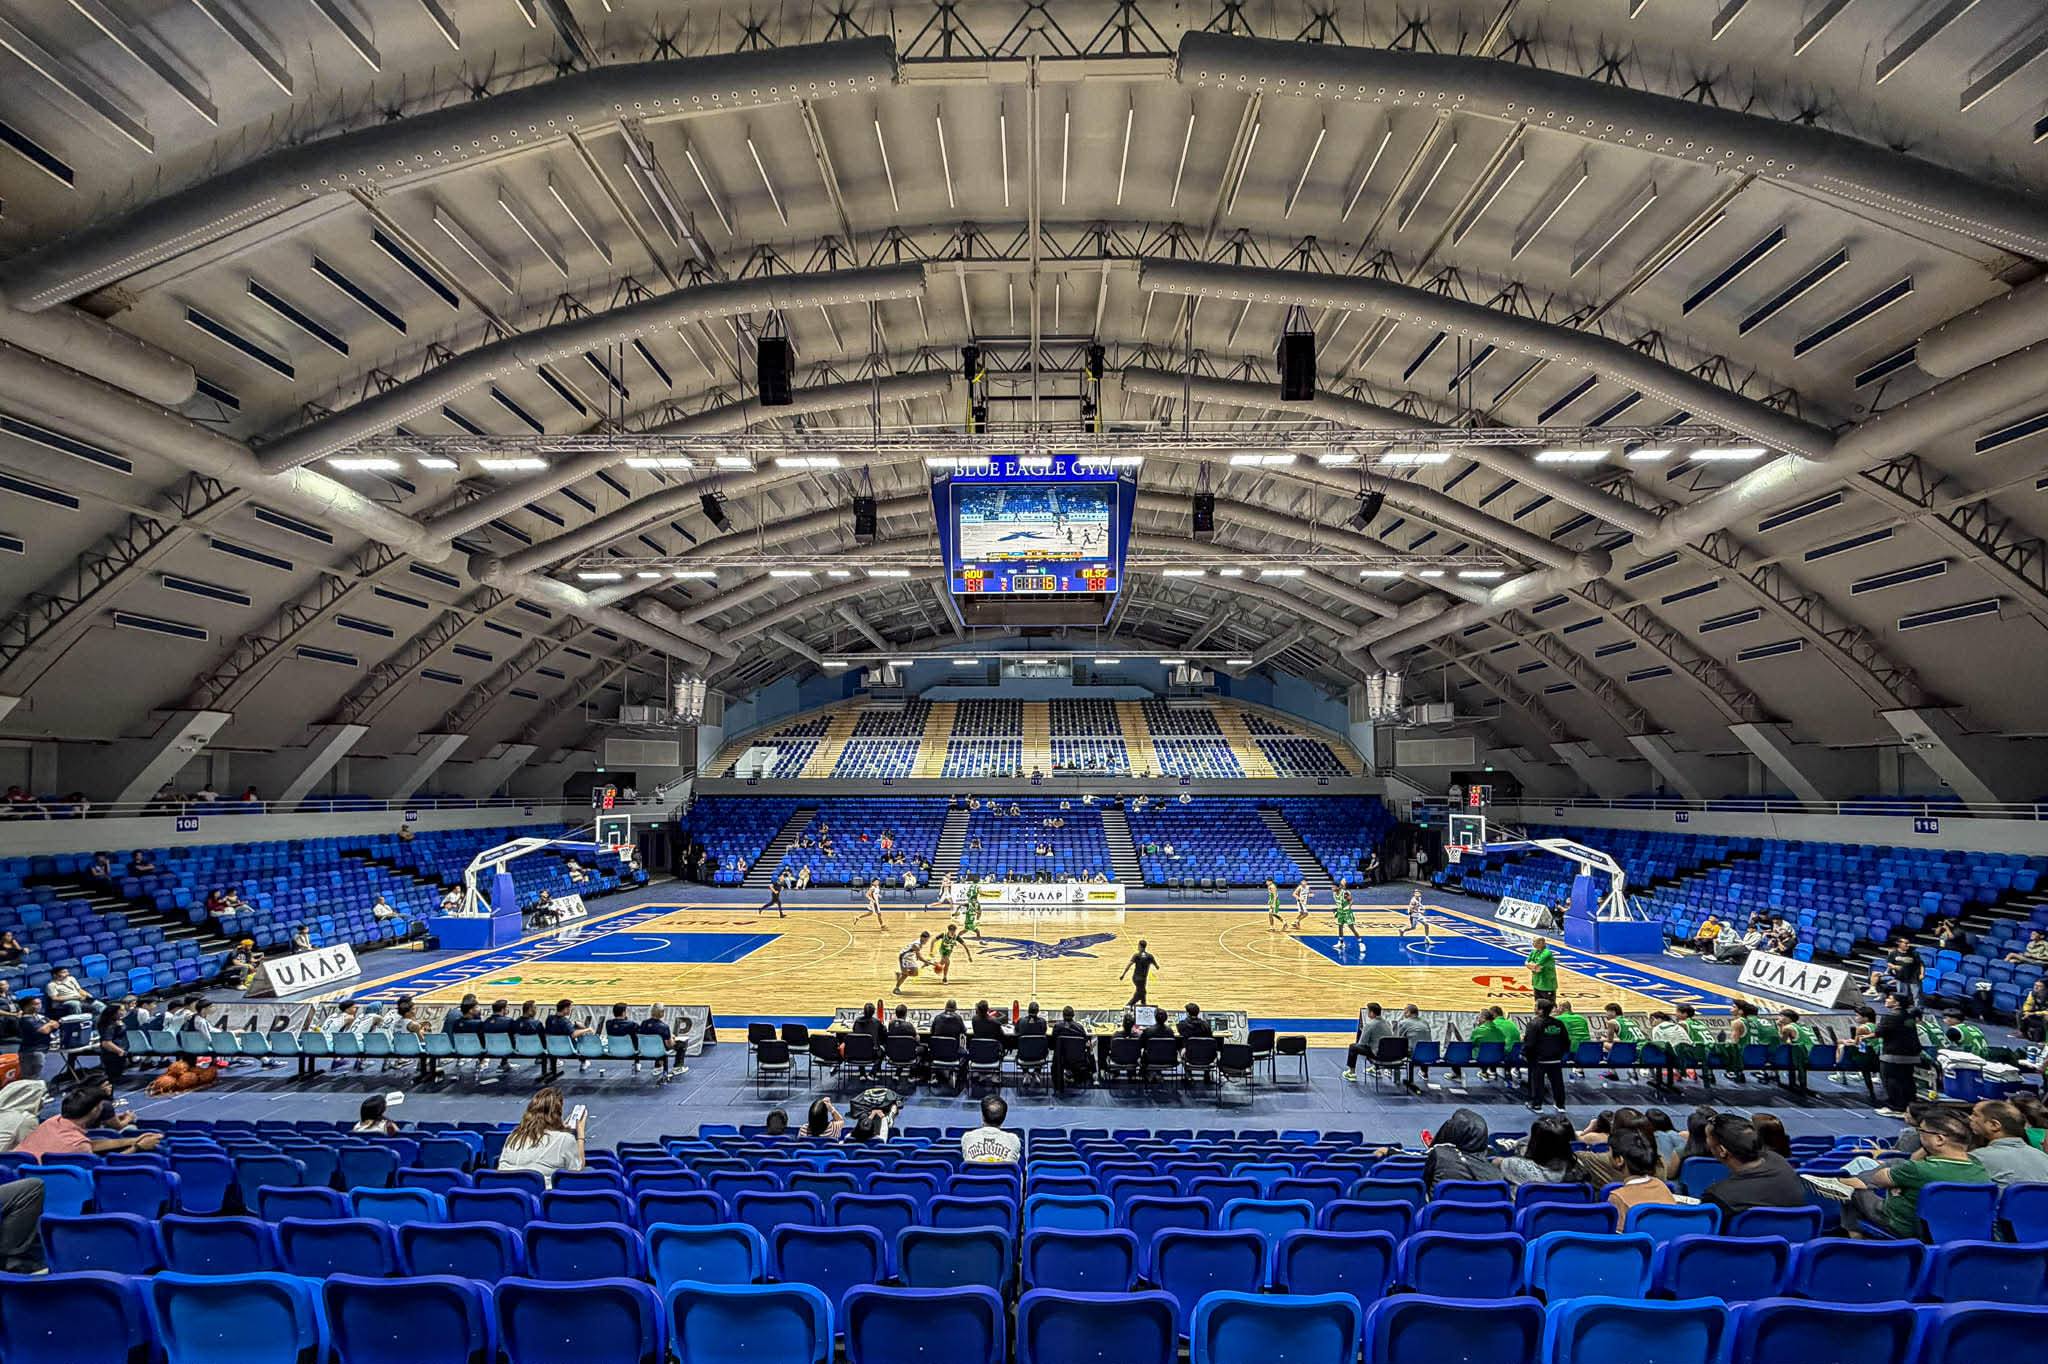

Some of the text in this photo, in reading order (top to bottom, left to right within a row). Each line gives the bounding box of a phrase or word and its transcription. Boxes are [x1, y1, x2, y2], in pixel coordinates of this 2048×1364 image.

[954, 461, 1115, 477] BLUE EAGLE GYM
[964, 569, 984, 579] ADU
[177, 820, 198, 829] 108
[1915, 821, 1938, 831] 118
[1028, 892, 1063, 900] UAAP
[276, 953, 346, 985] UAAP
[1752, 960, 1832, 994] UAAP
